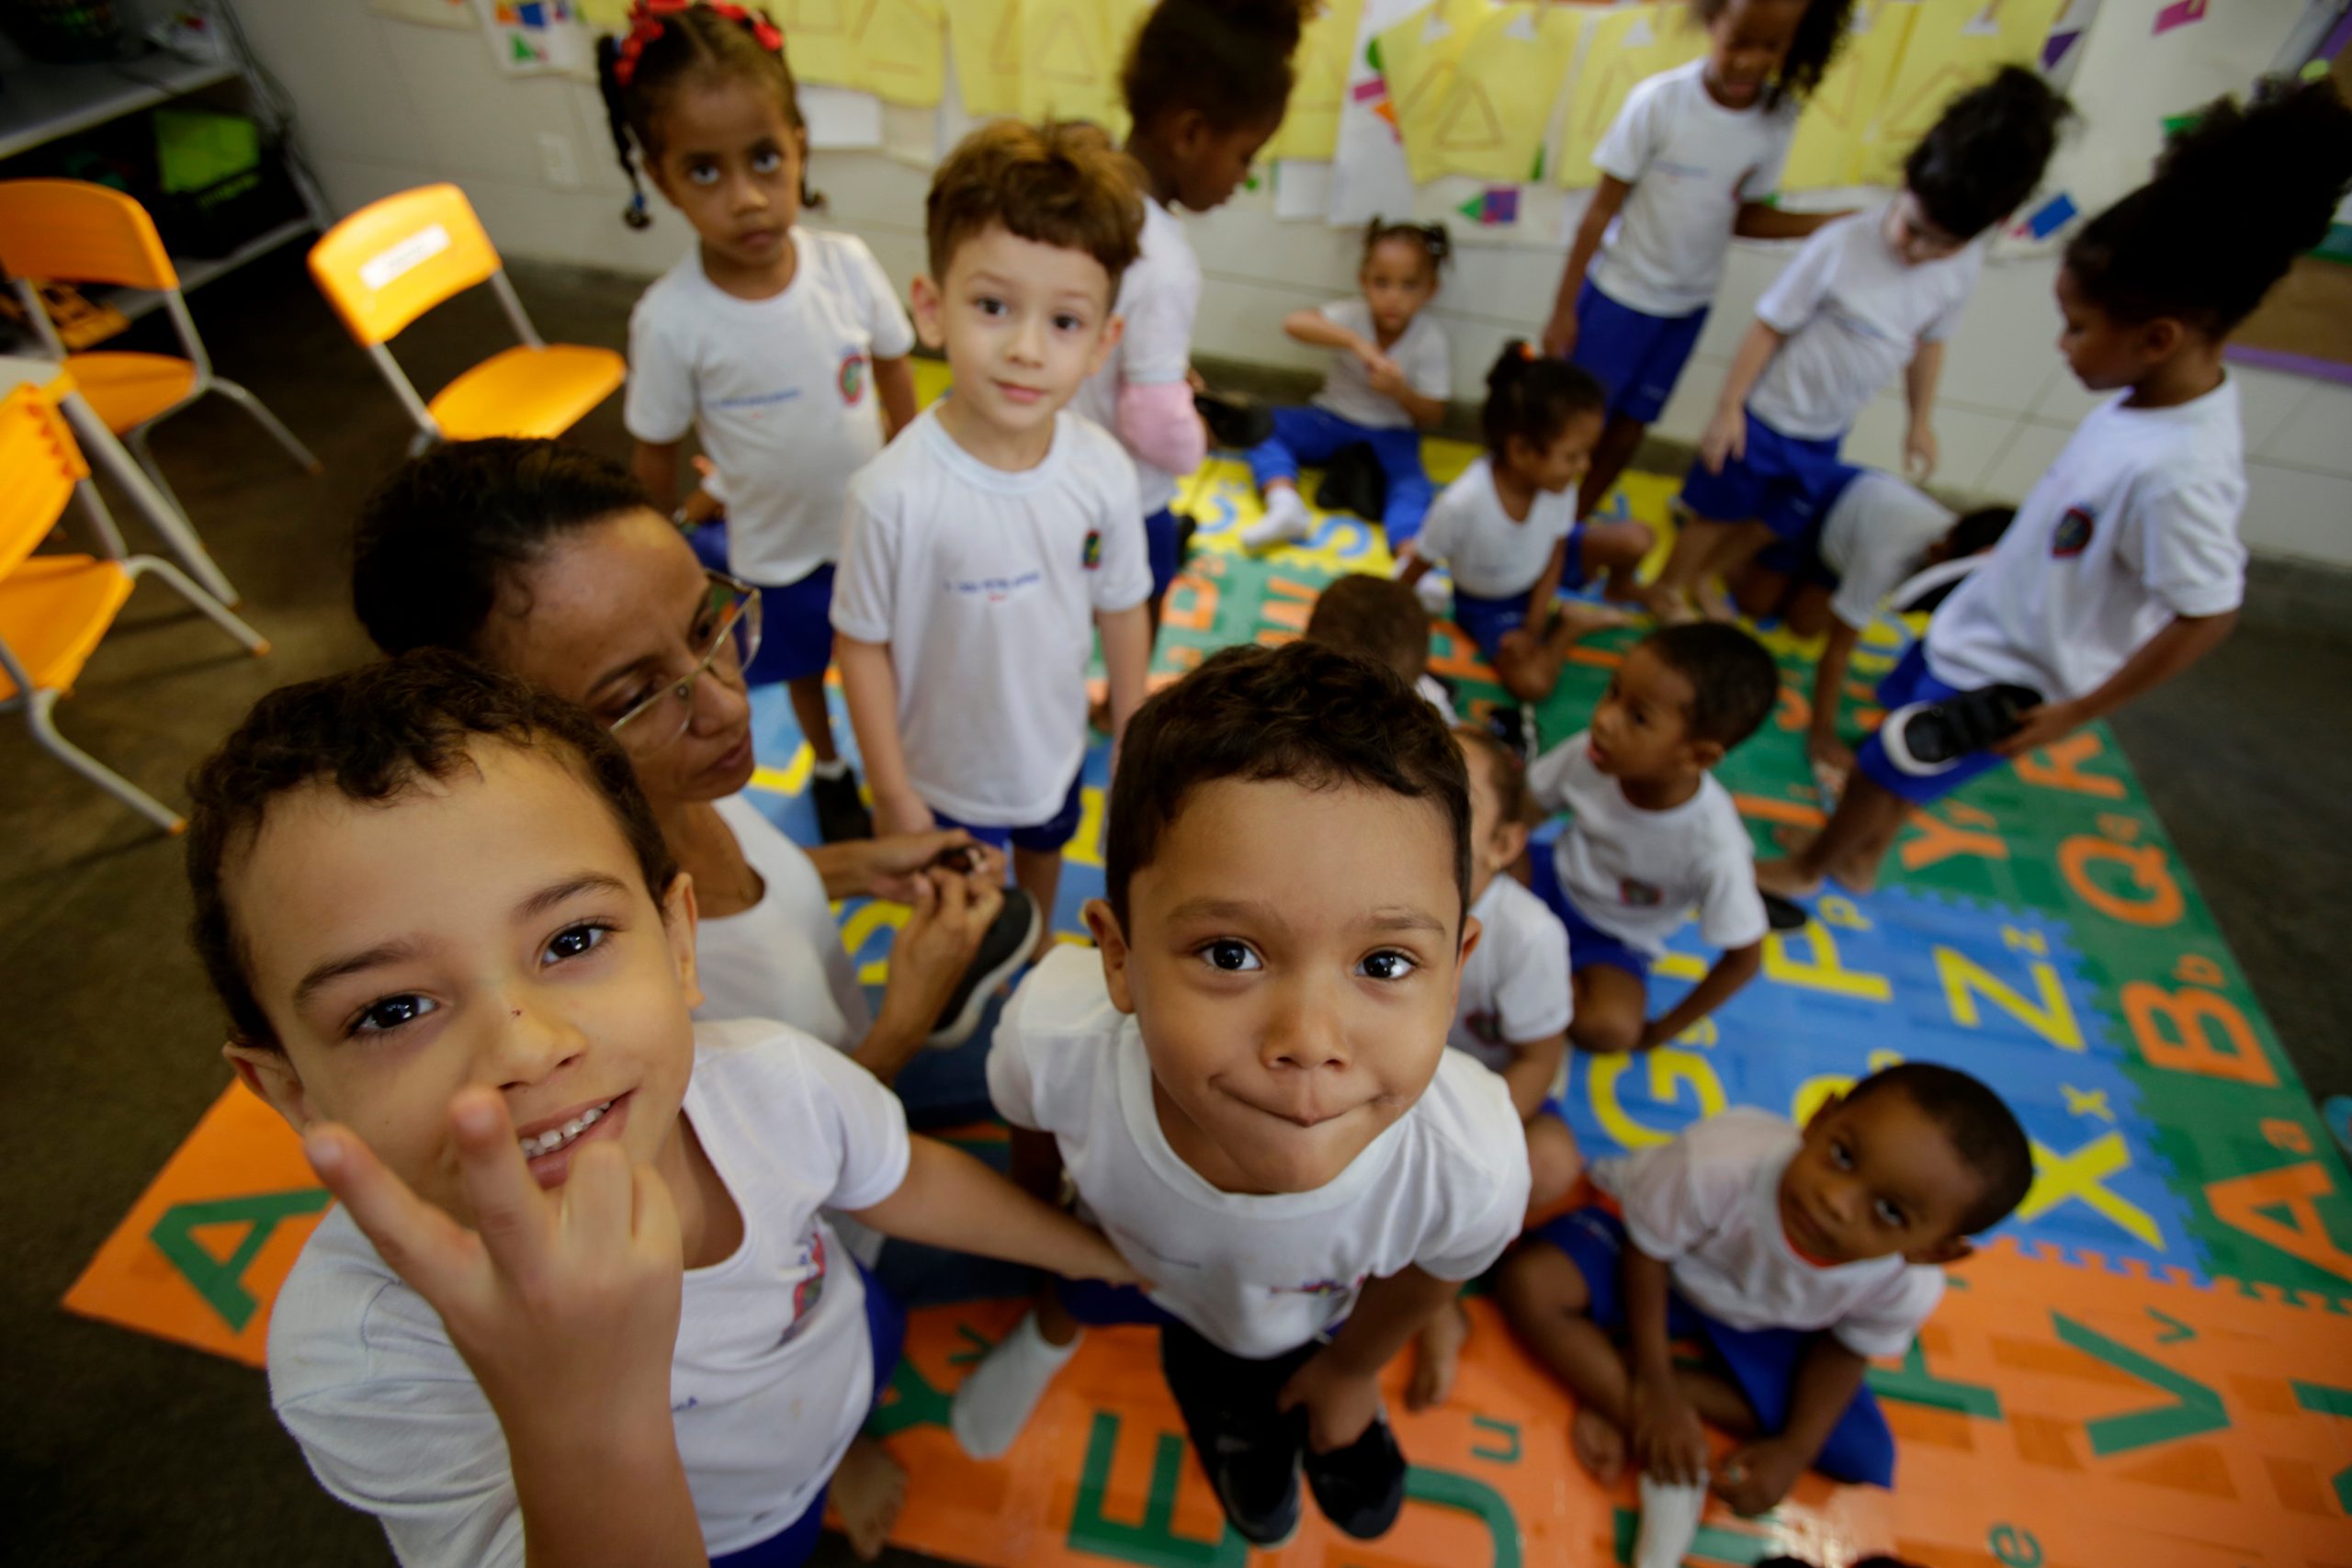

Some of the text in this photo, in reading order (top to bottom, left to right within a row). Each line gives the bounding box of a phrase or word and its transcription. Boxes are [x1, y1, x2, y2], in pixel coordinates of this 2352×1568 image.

[1901, 807, 2008, 871] Y
[2058, 834, 2185, 928] Q
[1762, 919, 1893, 1002] P
[1817, 895, 1871, 930] p
[1935, 944, 2086, 1052] Z
[2120, 953, 2282, 1088] B b
[1588, 1045, 1727, 1151] G
[2018, 1084, 2165, 1253] X x
[2203, 1159, 2352, 1280] A
[148, 1187, 332, 1333] A
[2047, 1304, 2231, 1456] V v
[1066, 1410, 1250, 1568] E
[1472, 1416, 1521, 1462] u
[1989, 1523, 2044, 1568] e
